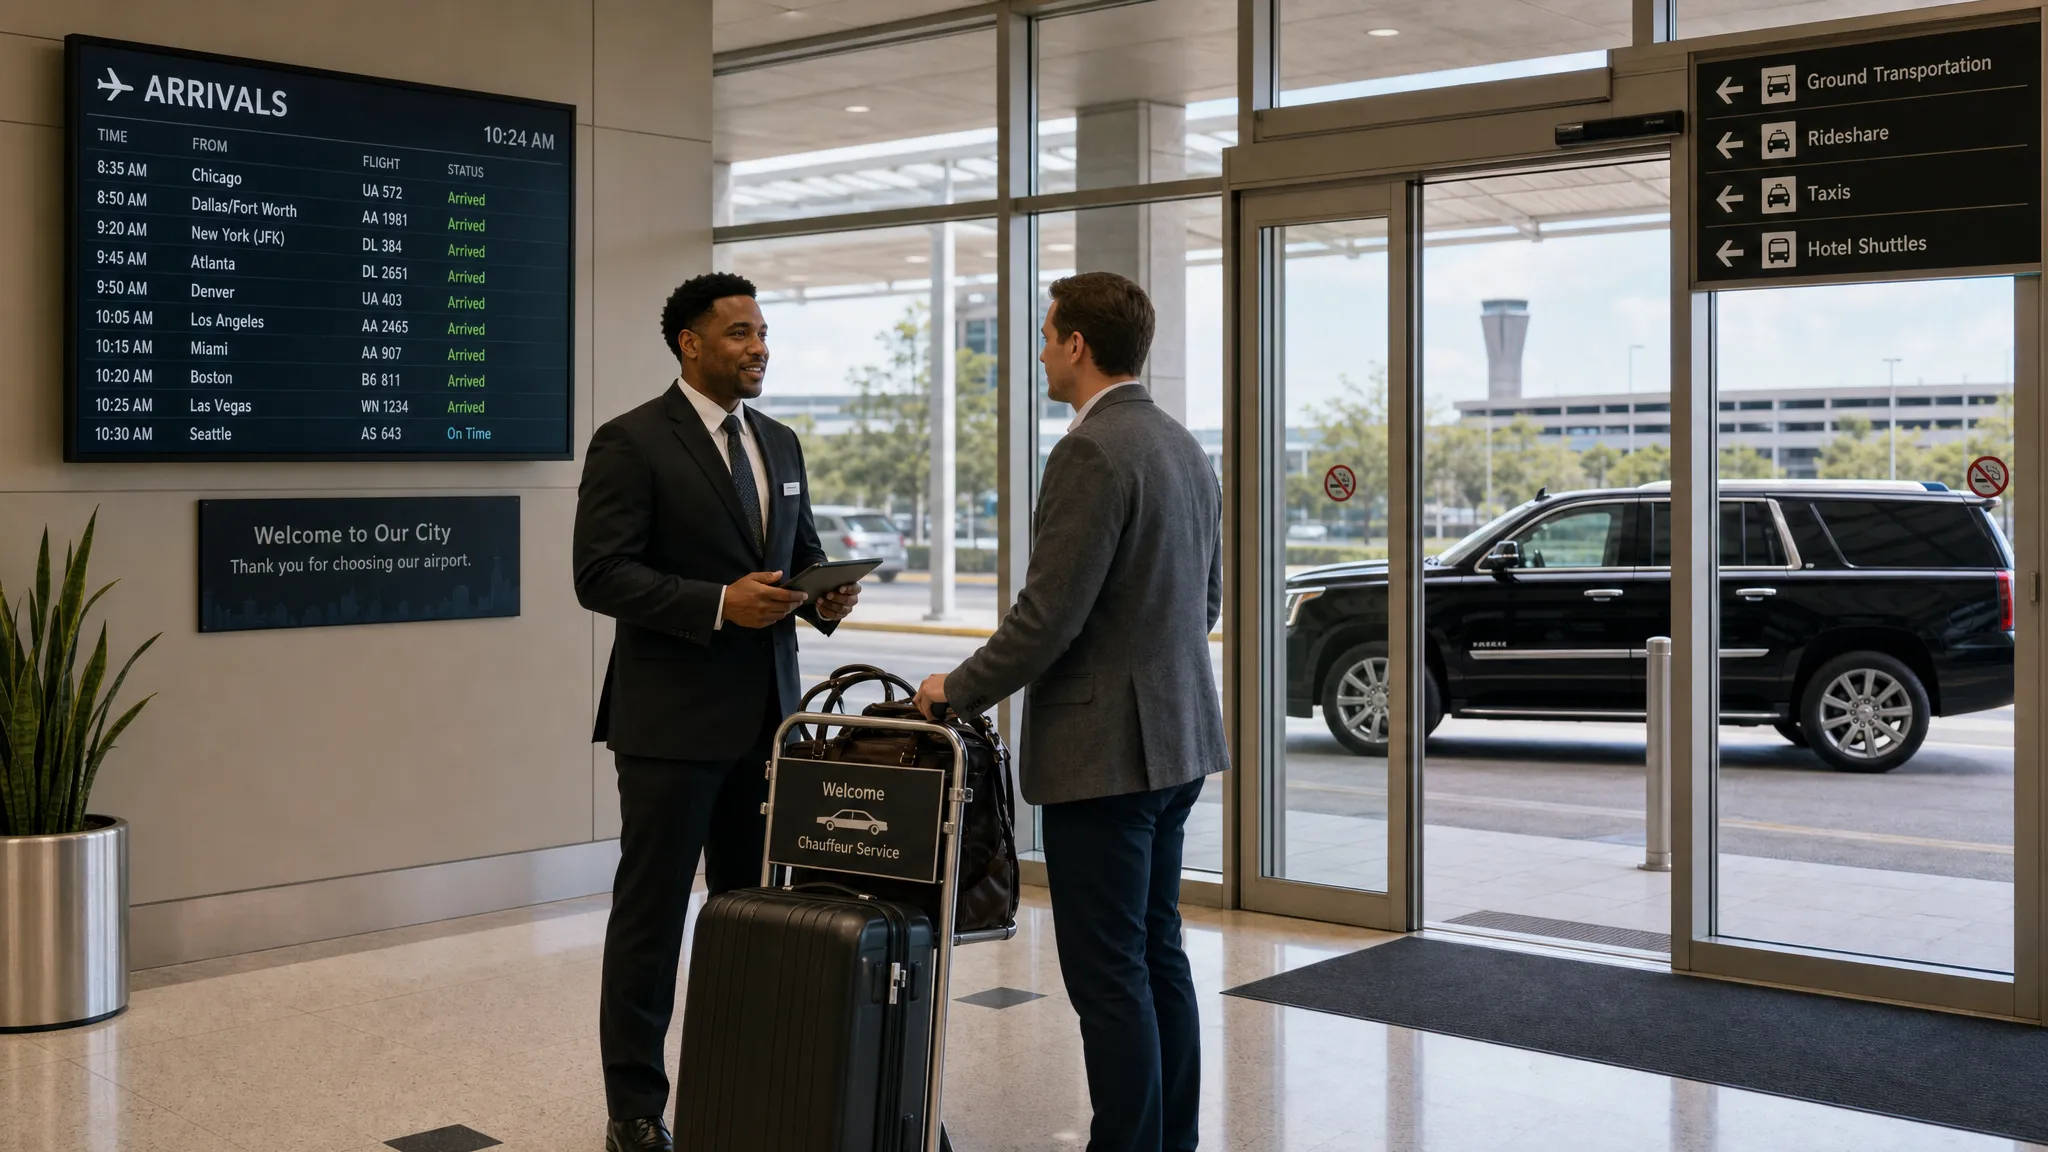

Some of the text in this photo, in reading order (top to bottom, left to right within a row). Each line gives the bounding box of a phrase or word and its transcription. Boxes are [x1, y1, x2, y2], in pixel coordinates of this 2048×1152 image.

[1807, 55, 1992, 90] Ground Transportation
[144, 74, 288, 117] ARRIVALS
[483, 125, 554, 150] 10:24 AM
[1808, 126, 1889, 147] Rideshare
[97, 127, 484, 178] TIME FROM FLIGHT STATUS
[97, 159, 486, 207] 8:35 AM Chicago UA 572 Arrived
[1807, 183, 1851, 202] Taxis
[97, 189, 486, 232] 8:50 AM Dallas/Fort Worth AA 1981 Arrived
[97, 219, 486, 258] 9:20 AM New York (JFK) DL 384 Arrived
[1808, 234, 1927, 257] Hotel Shuttles
[97, 249, 486, 284] 9:45 AM Atlanta DL 2651 Arrived
[96, 279, 485, 310] 9:50 AM Denver UA 403 Arrived
[96, 309, 485, 336] 10:05 AM Los Angeles AA 2465 Arrived
[96, 338, 485, 362] 10:15 AM Miami AA 907 Arrived
[95, 368, 485, 388] 10:20 AM Boston B6 811 Arrived
[95, 397, 485, 416] 10:25 AM Las Vegas WN 1234 Arrived
[95, 426, 492, 441] 10:30 AM Seattle AS 643 On Time
[253, 522, 452, 546] Welcome to Our City
[229, 553, 471, 577] Thank you for choosing our airport.
[822, 781, 885, 801] Welcome
[797, 835, 900, 859] Chauffeur Service
